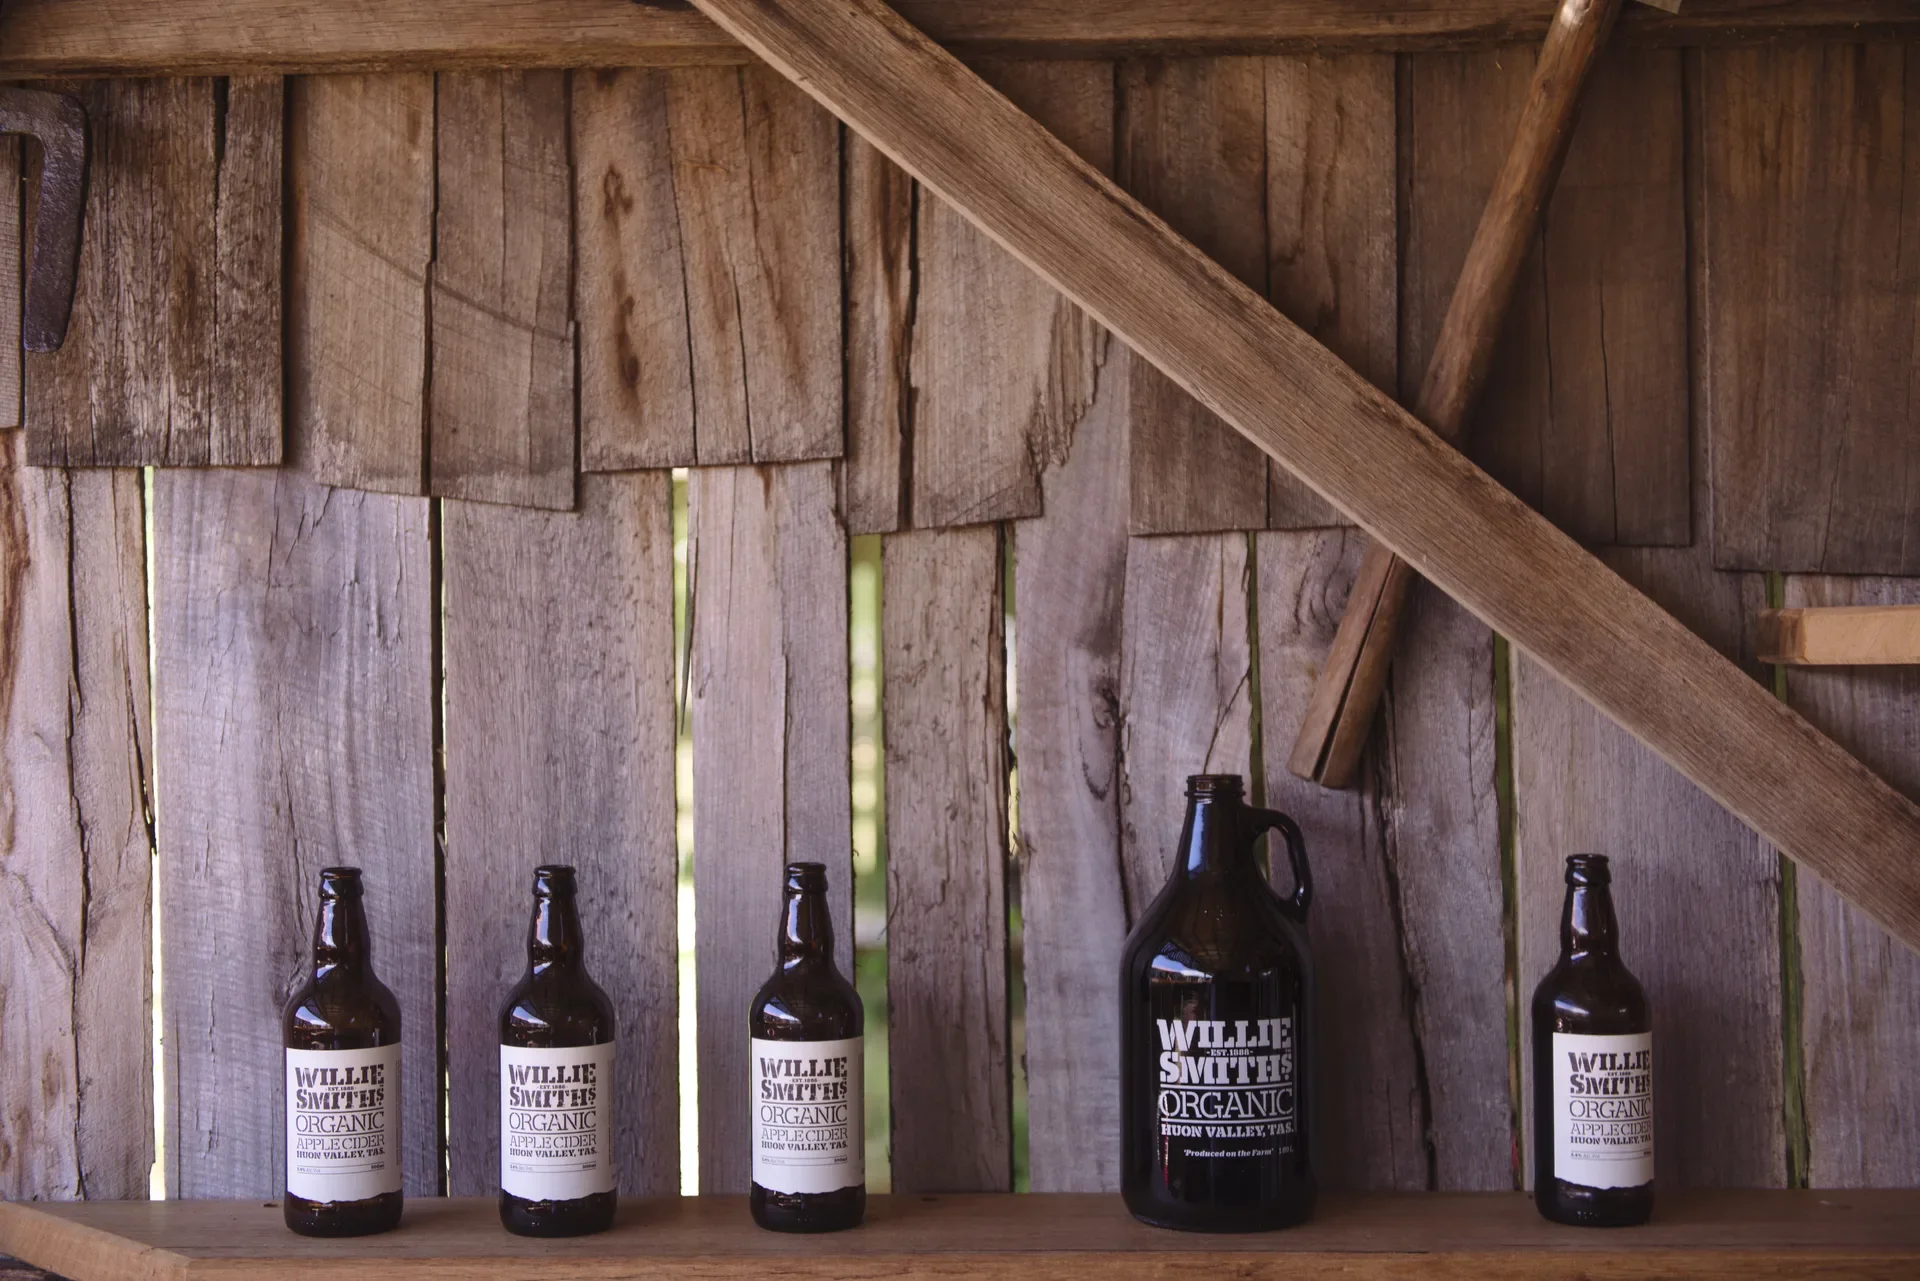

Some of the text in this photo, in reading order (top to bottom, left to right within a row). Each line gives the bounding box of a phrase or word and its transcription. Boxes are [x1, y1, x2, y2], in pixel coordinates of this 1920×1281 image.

[1156, 1017, 1292, 1052] WILLIE
[760, 1057, 847, 1079] WILLIE
[1568, 1050, 1650, 1073] WILLIE
[295, 1063, 384, 1088] WILLIE
[508, 1063, 596, 1085] WILLIE
[1159, 1088, 1293, 1119] ORGANIC
[1569, 1098, 1650, 1118] ORGANIC
[296, 1111, 384, 1133] ORGANIC
[509, 1111, 596, 1131] ORGANIC
[760, 1105, 848, 1125] ORGANIC
[761, 1127, 848, 1142] APPLE CIDER
[1161, 1122, 1295, 1138] HUON VALLEY, TAS.
[1570, 1122, 1619, 1136] APPLE
[296, 1134, 385, 1151] APPLE CIDER
[509, 1133, 597, 1149] APPLE CIDER
[761, 1141, 786, 1150] HUON
[788, 1142, 829, 1151] VALLEY,
[1570, 1136, 1600, 1144] HUON
[296, 1151, 321, 1159] HUON
[324, 1150, 365, 1159] VALLEY,
[509, 1148, 533, 1157] HUON
[536, 1149, 577, 1158] VALLEY,
